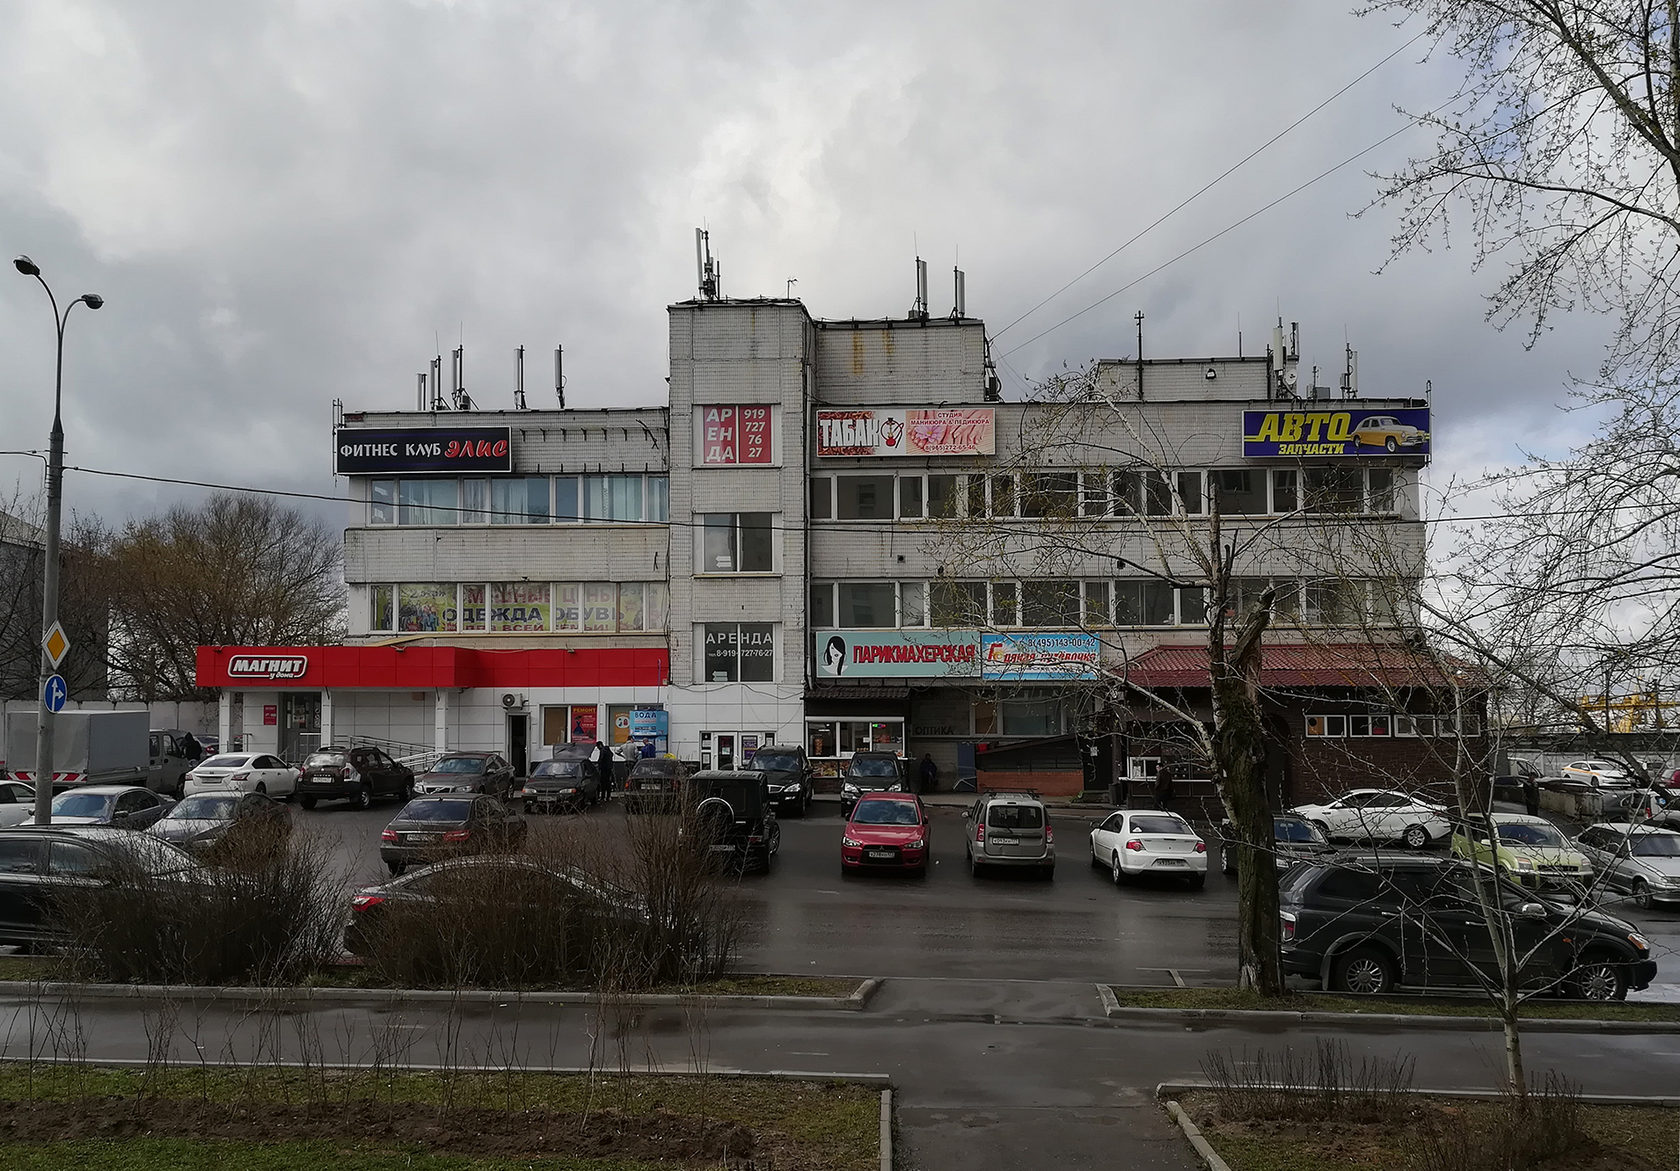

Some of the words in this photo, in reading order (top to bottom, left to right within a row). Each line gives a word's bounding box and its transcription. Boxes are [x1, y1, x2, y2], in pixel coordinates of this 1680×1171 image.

[706, 408, 733, 422] АР
[744, 409, 765, 419] 919
[745, 422, 766, 432] 727
[820, 419, 880, 447] ТАБАК
[1256, 413, 1351, 442] АВТО
[707, 427, 733, 441] ЕН
[748, 435, 762, 445] 76
[340, 443, 398, 457] ФИТНЕС
[405, 443, 441, 458] КЛУБ
[444, 440, 508, 458] ЭЛИС
[706, 446, 734, 462] ДА
[748, 448, 762, 458] 27
[1278, 444, 1344, 455] ЗАПЧАСТИ
[562, 587, 616, 603] ЦНЫ
[442, 607, 543, 623] ОДЕЖДА
[706, 632, 773, 645] АРЕНДА
[853, 645, 976, 663] ПАРИКМАХЕРСКАЯ
[233, 660, 303, 672] МАГНИТ
[276, 671, 294, 679] дома
[915, 726, 953, 735] ОПТИКА
